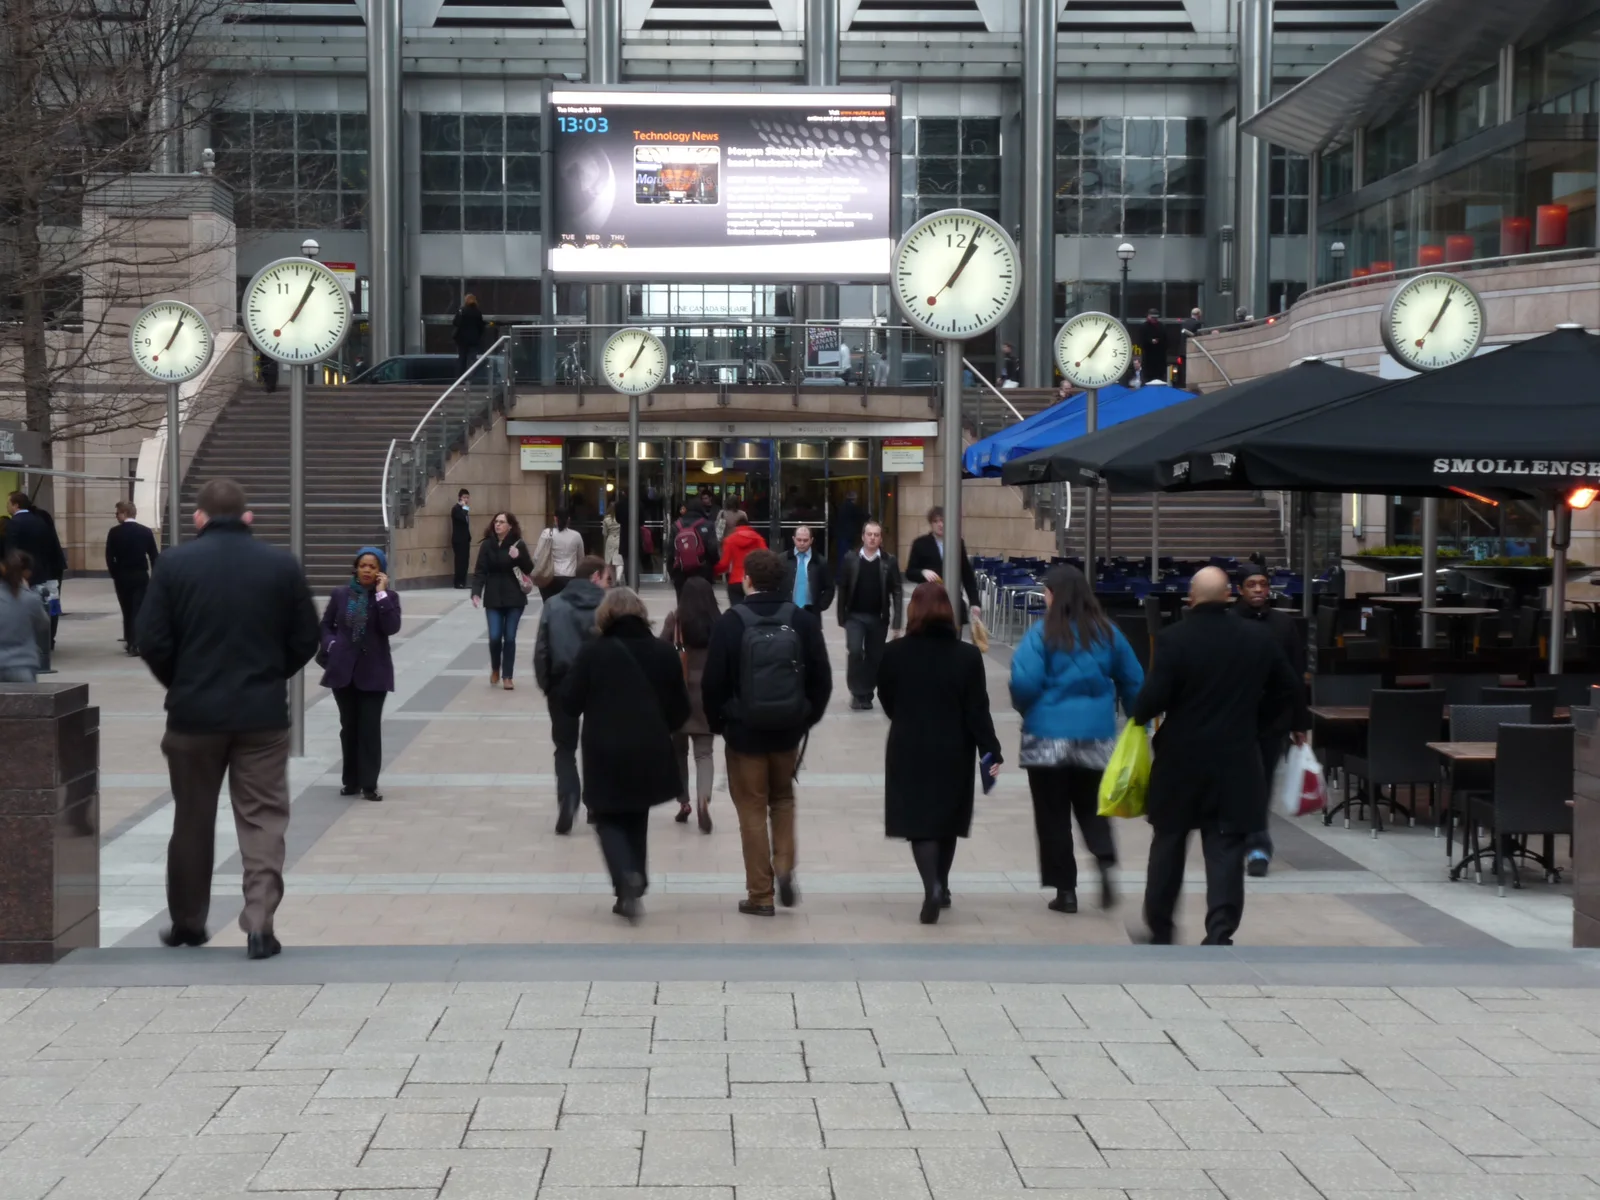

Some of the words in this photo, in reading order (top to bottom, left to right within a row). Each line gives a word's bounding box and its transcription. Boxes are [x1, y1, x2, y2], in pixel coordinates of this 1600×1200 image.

[558, 117, 609, 133] 13:03
[633, 131, 690, 142] Technology
[692, 132, 719, 141] News
[728, 147, 764, 157] Morgan
[765, 147, 800, 157] Stanley
[946, 234, 966, 248] 12
[276, 282, 289, 295] 11
[145, 338, 152, 347] 9
[810, 336, 838, 346] CANARY
[811, 341, 838, 352] WHARF
[1112, 348, 1118, 358] 3
[1433, 458, 1600, 477] SMOLLENSK
